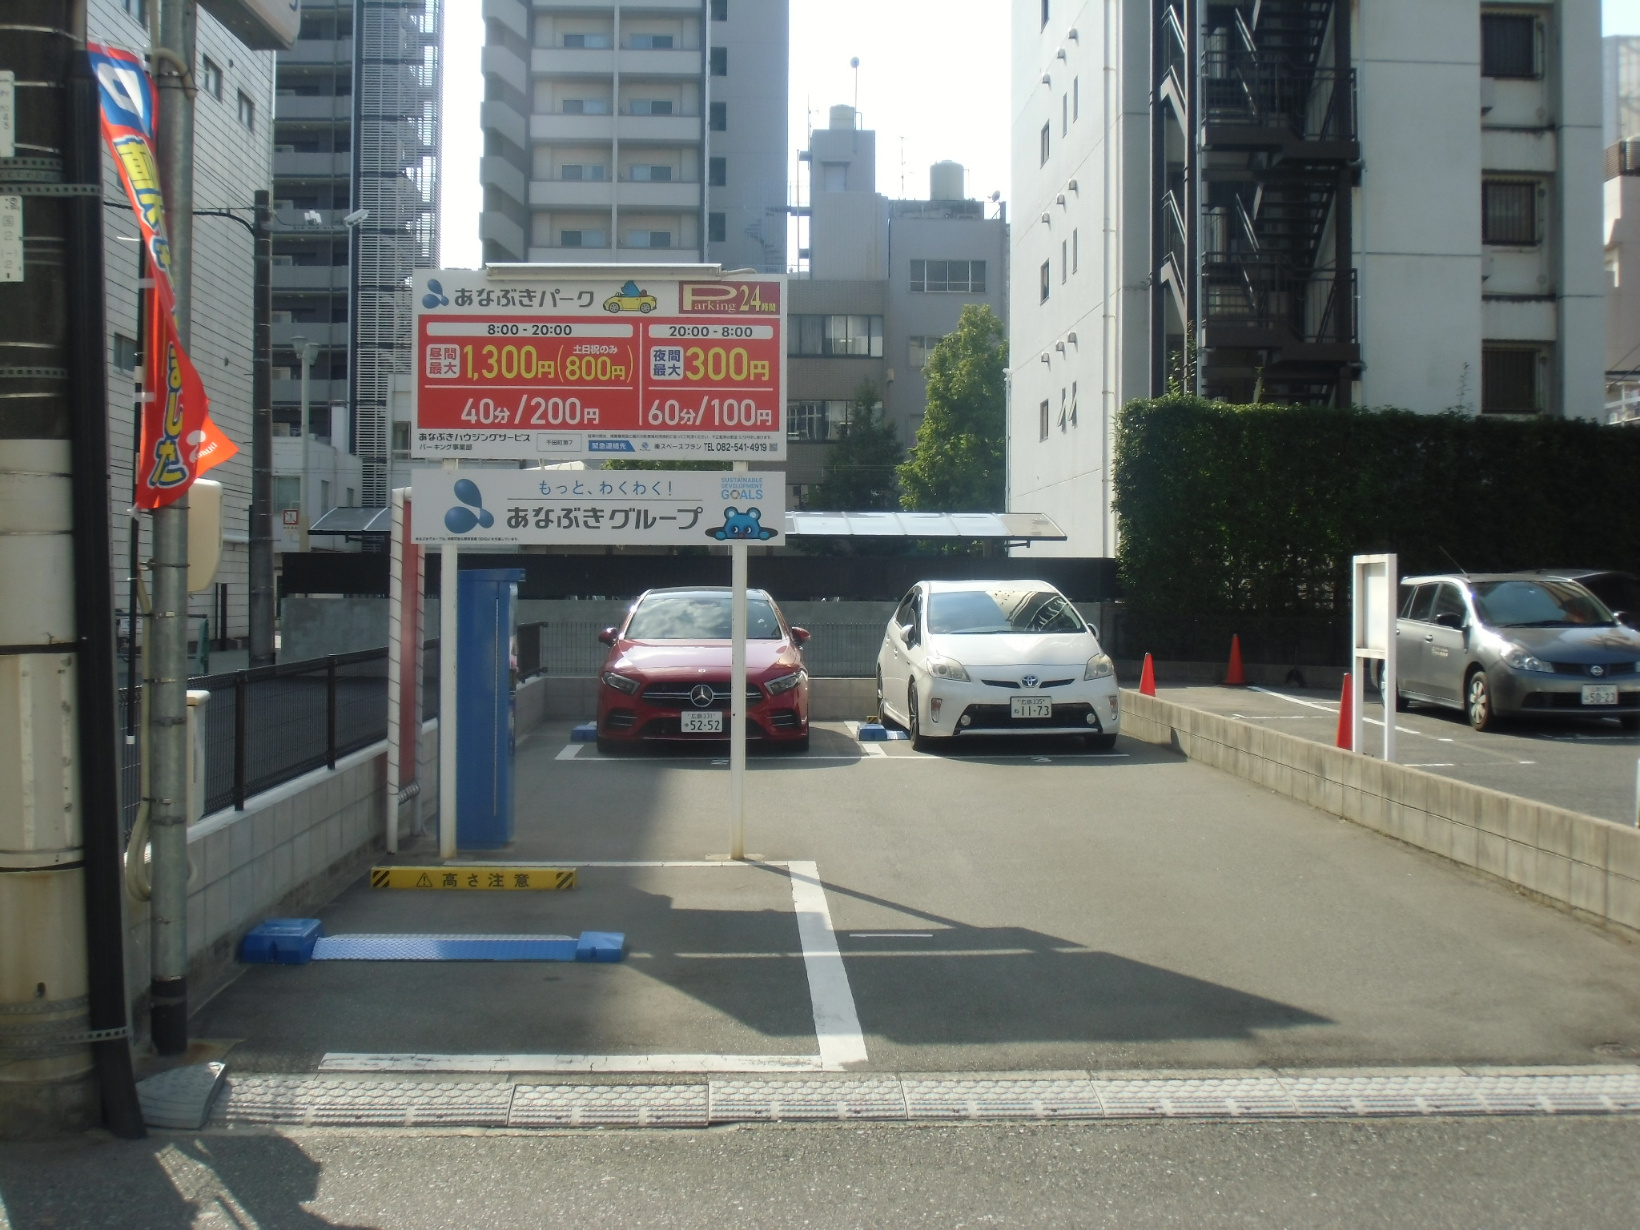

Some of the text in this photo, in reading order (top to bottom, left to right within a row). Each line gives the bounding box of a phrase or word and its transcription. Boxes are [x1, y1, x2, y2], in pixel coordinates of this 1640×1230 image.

[454, 288, 594, 308] あなぶきパーク
[682, 284, 776, 313] Parking 24時間
[487, 324, 519, 336] 8:00
[532, 324, 573, 336] 20:00
[669, 326, 710, 337] 20:00
[721, 326, 753, 338] 8:00
[429, 347, 457, 360] 昼間
[573, 345, 618, 354] 土日祝のみ
[653, 349, 681, 362] 夜間
[429, 362, 457, 375] 最大
[463, 344, 555, 381] 1,300円
[685, 347, 770, 381] 300円
[653, 364, 681, 377] 最大
[418, 433, 531, 442] あなぶきハウジングサービス
[419, 443, 473, 451] パーキング事業部
[704, 442, 768, 452] TEL 082-541-4919
[721, 489, 764, 500] GOALS
[506, 506, 704, 530] あなぶきグループ
[442, 873, 531, 888] 高さ注意
